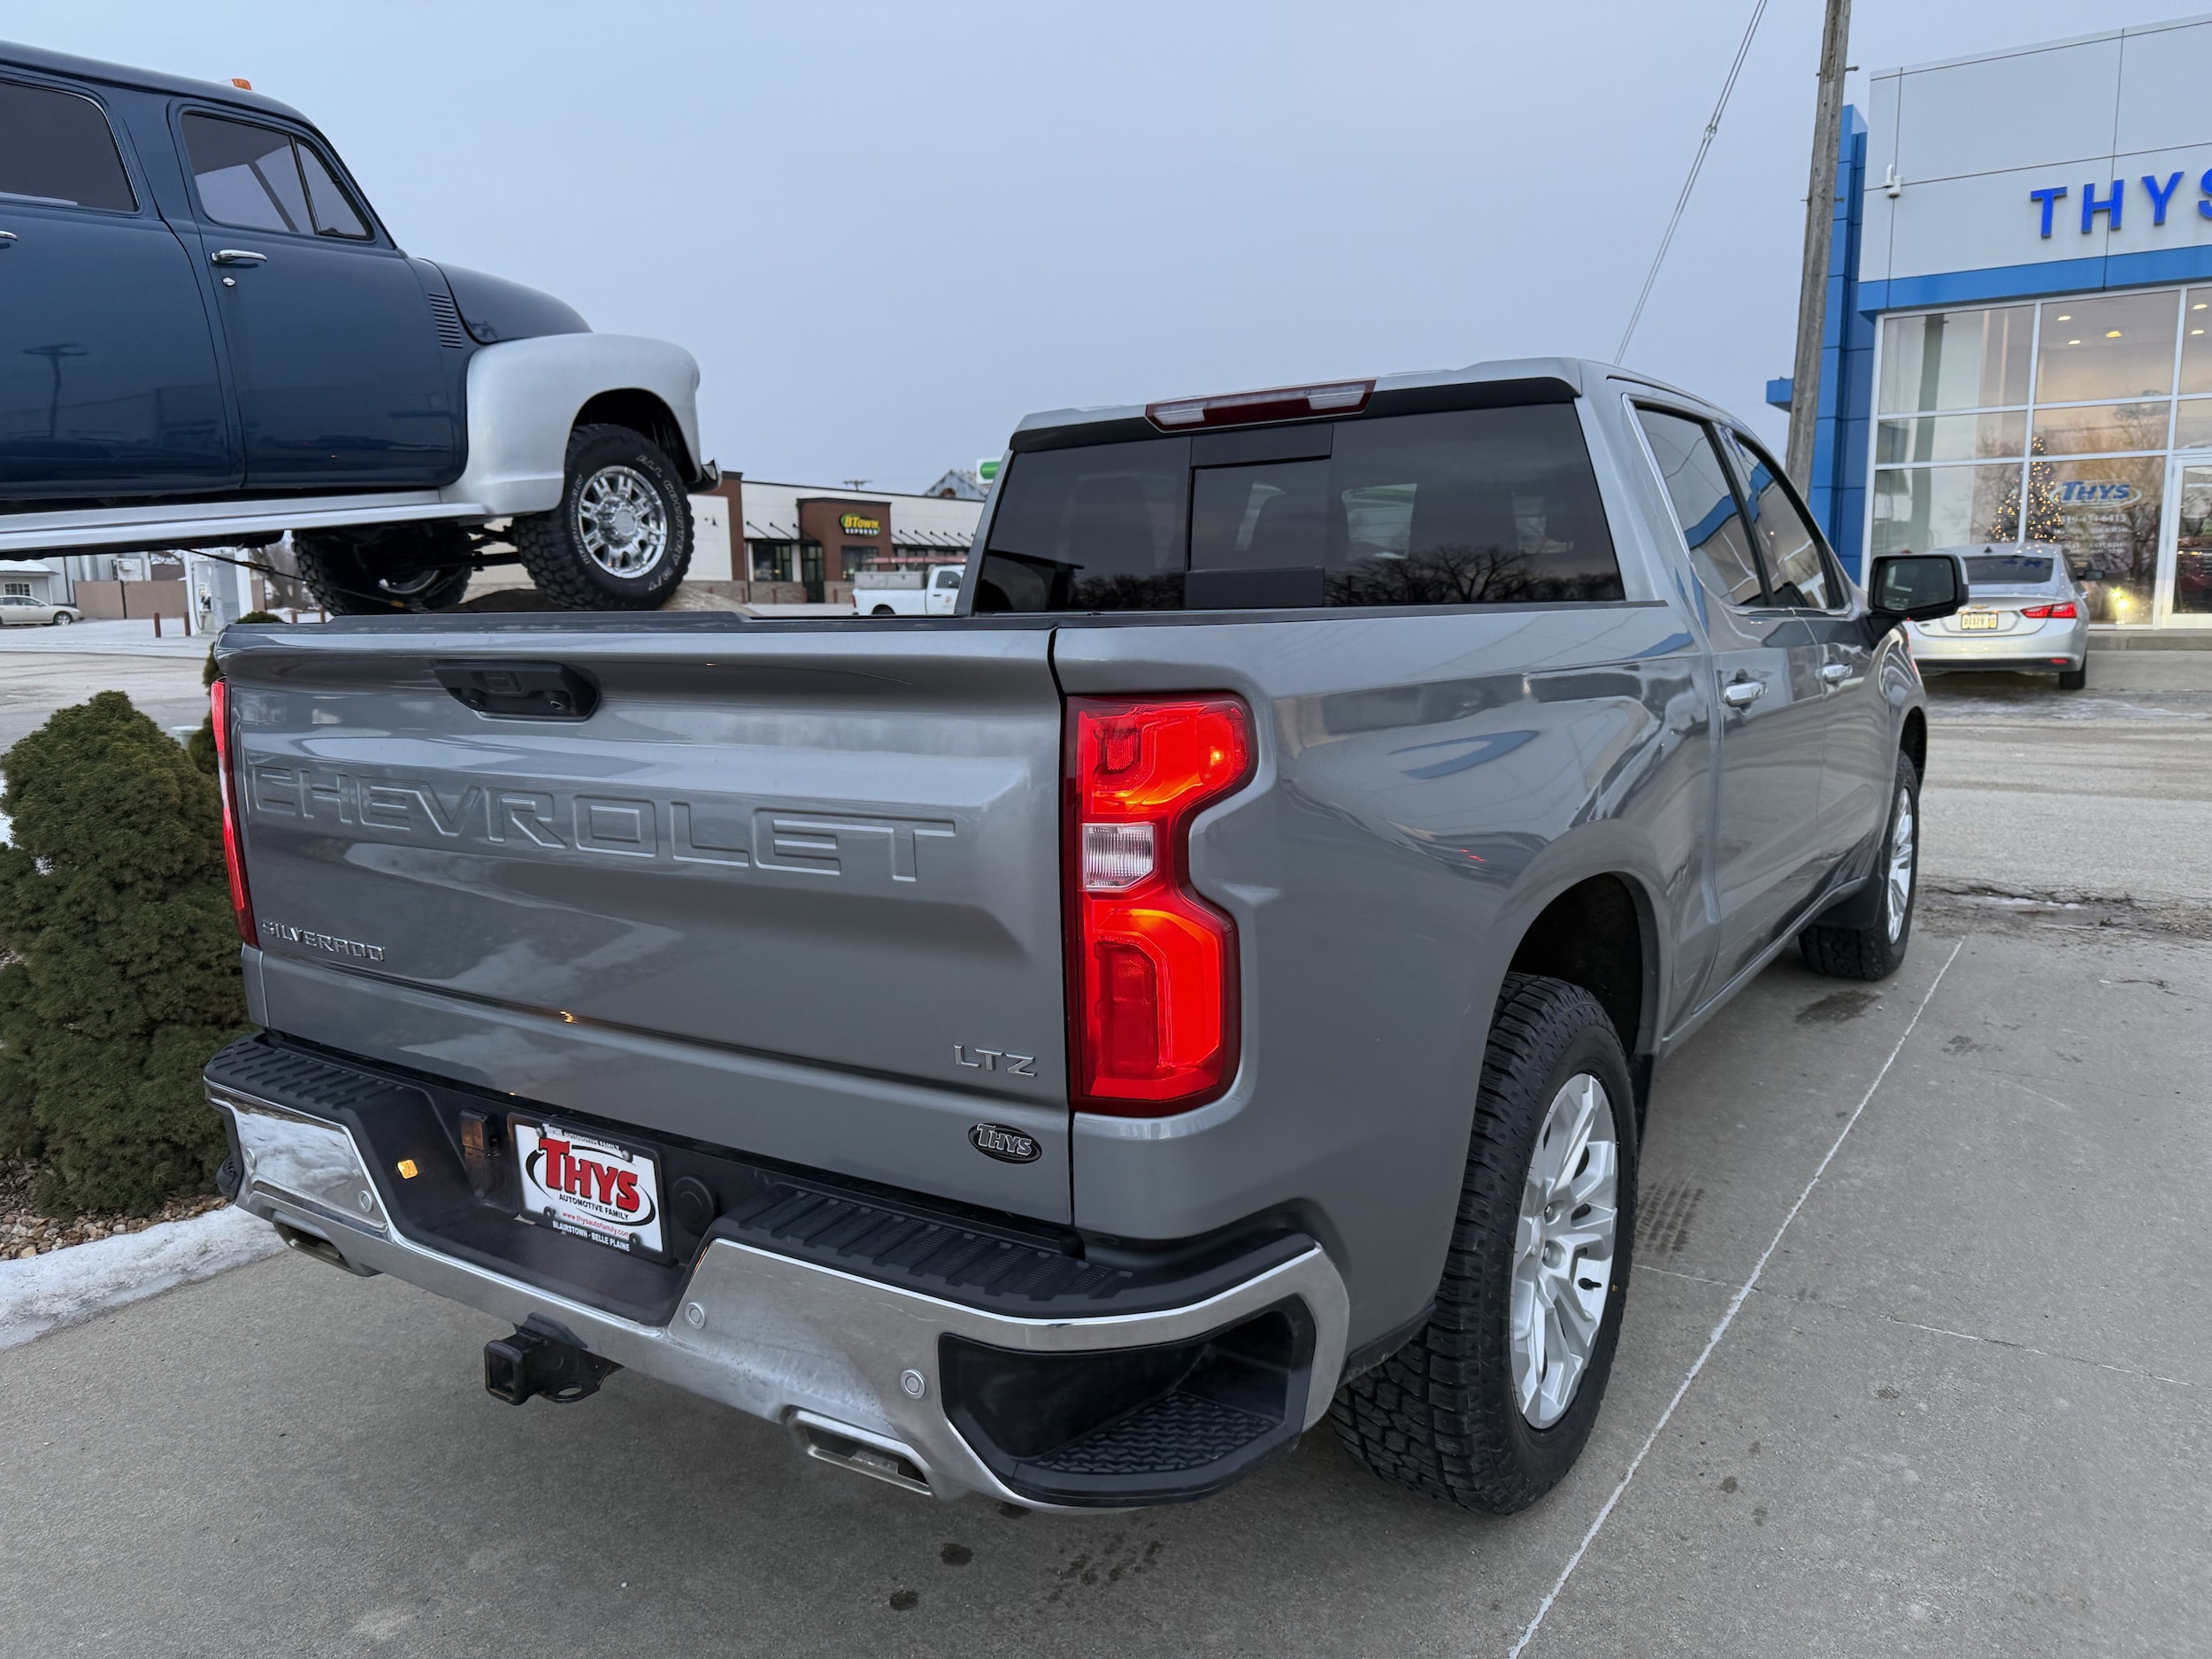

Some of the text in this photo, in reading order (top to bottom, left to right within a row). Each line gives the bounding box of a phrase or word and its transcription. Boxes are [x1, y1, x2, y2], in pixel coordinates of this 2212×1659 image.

[2061, 480, 2131, 502] THYS
[252, 765, 956, 882] CHEVROLET
[262, 920, 385, 962] SILVERADO
[953, 1043, 1037, 1076] LTZ
[976, 1123, 1033, 1156] THYS
[538, 1137, 641, 1214] THYS
[559, 1194, 629, 1221] AUTOMOTIVE FAMILY
[562, 1211, 630, 1237] www.thysautofamily.com
[552, 1220, 631, 1252] BLAIRSTOWN BELLE PLAINE
